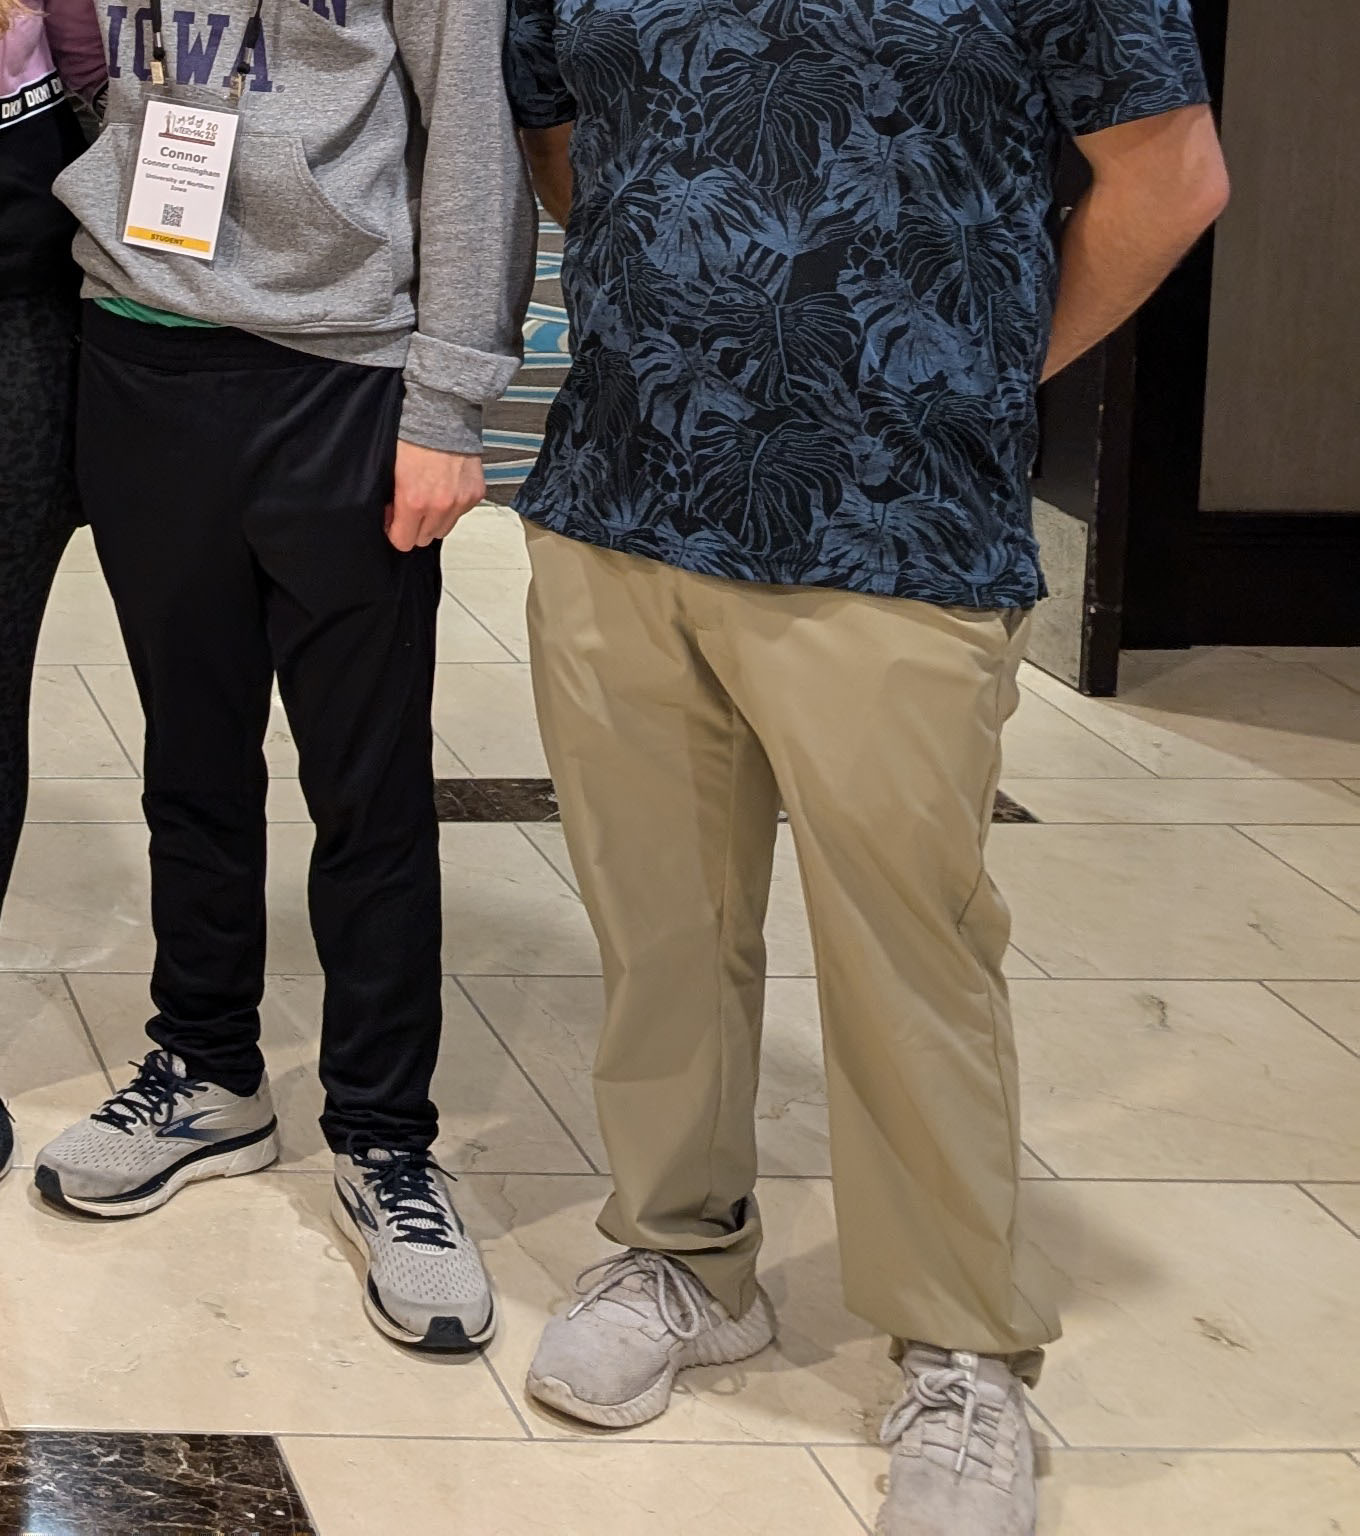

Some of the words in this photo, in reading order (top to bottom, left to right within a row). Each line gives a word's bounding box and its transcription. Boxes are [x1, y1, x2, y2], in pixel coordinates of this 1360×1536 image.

[160, 146, 208, 164] Connor
[142, 158, 170, 168] Connor
[172, 164, 221, 177] Cunningham
[151, 233, 185, 246] STUDENT
